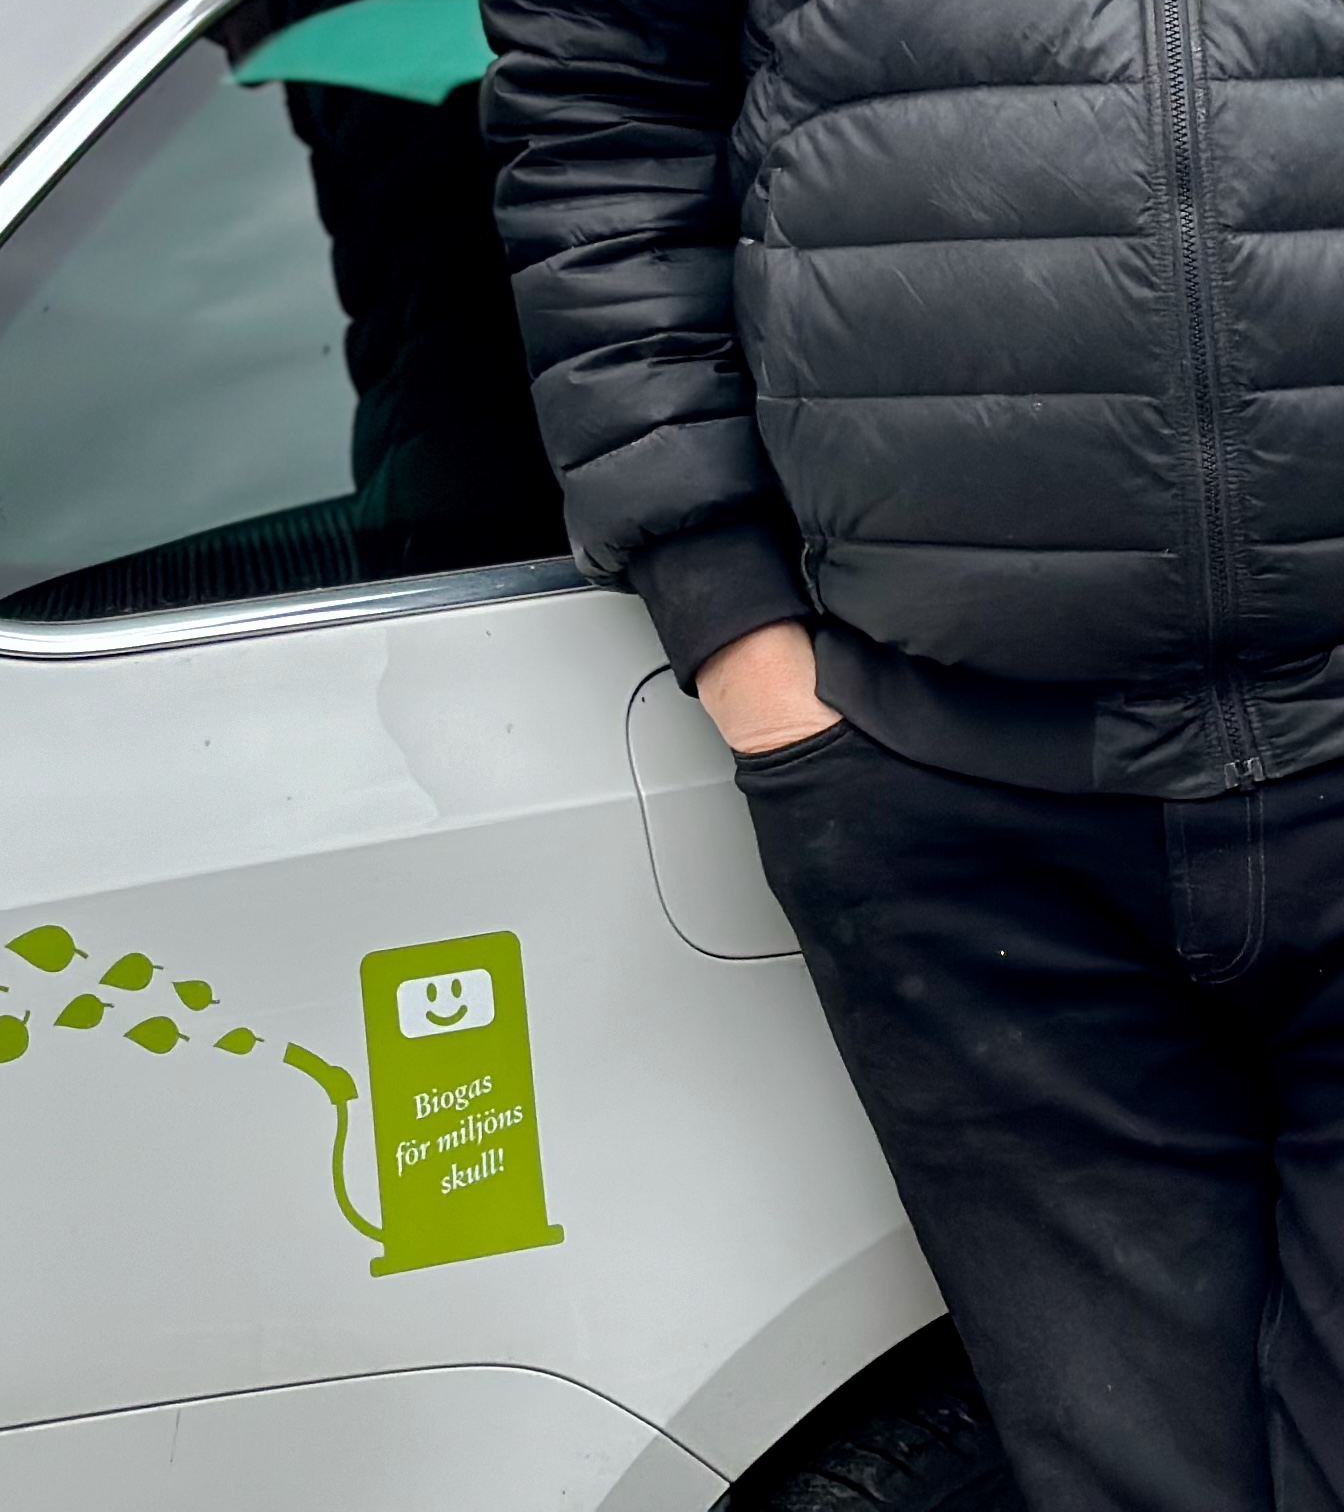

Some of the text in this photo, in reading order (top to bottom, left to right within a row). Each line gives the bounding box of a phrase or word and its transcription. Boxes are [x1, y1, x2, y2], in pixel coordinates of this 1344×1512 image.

[413, 1074, 493, 1120] Biogas
[395, 1104, 524, 1178] för miljöns
[440, 1146, 505, 1195] skull!
